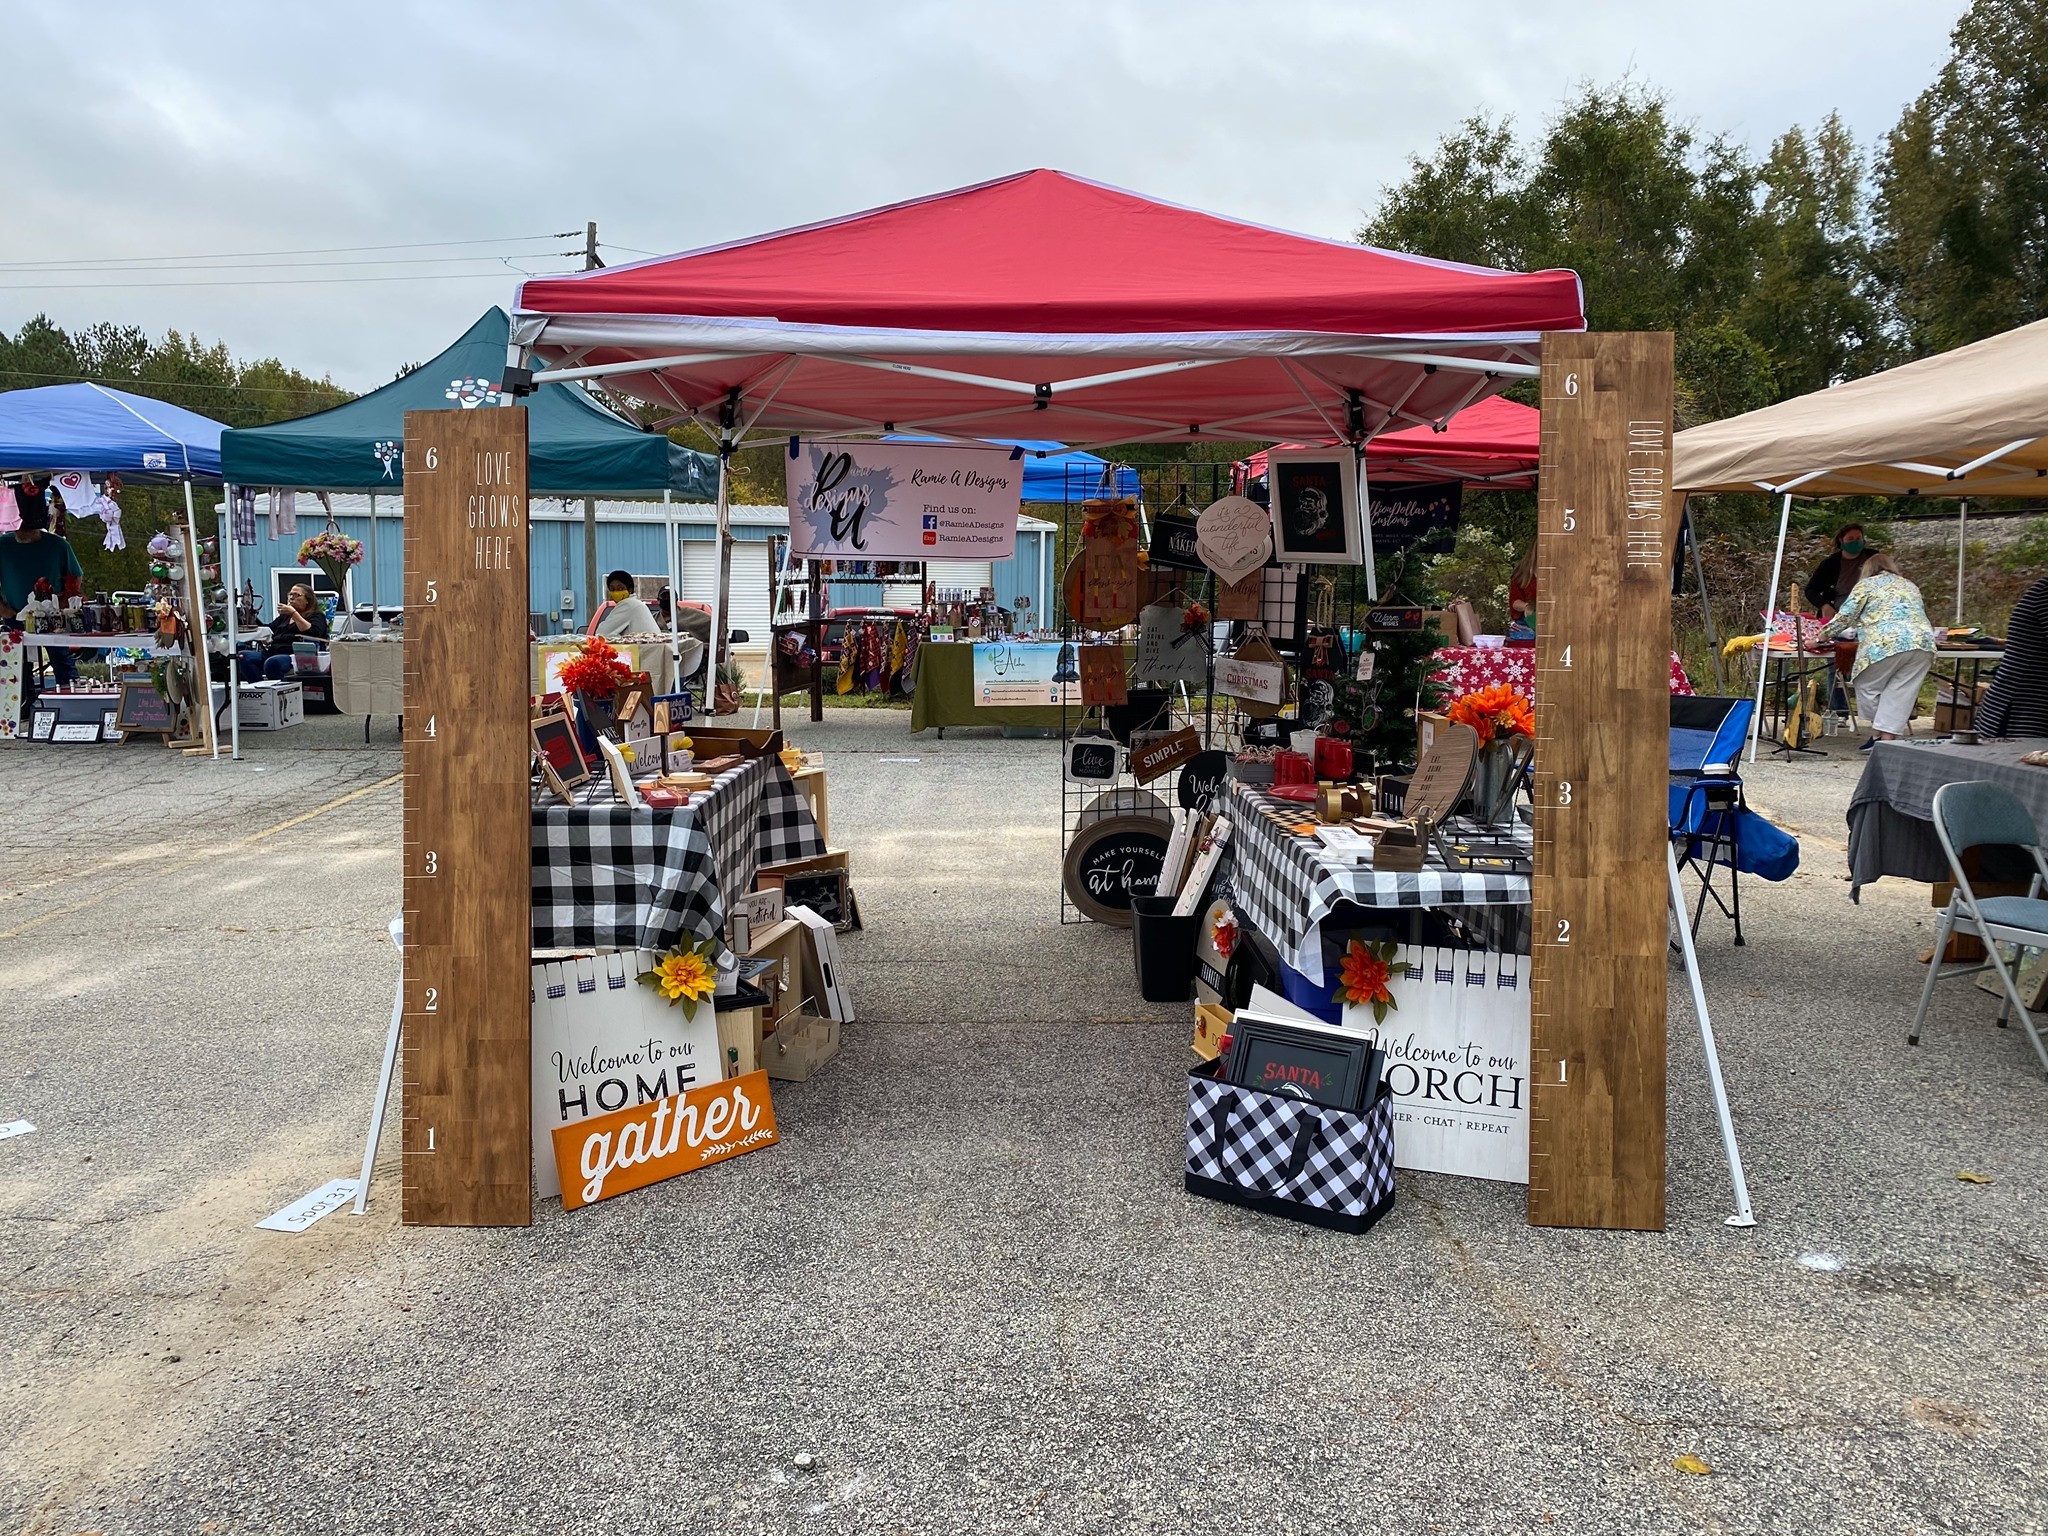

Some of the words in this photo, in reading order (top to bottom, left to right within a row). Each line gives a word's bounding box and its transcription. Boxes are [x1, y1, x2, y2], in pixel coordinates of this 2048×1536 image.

[1565, 373, 1578, 396] 6
[1628, 421, 1664, 456] LOVE
[426, 447, 437, 469] 6
[476, 452, 511, 486] LOVE
[911, 468, 947, 487] Ramie
[950, 470, 960, 486] A
[964, 470, 1009, 494] Designs
[803, 481, 874, 519] designs
[1628, 467, 1663, 521] GROWS
[468, 494, 519, 528] GROWS
[923, 504, 945, 514] Find
[948, 506, 960, 514] us
[962, 506, 976, 514] on:
[1562, 509, 1576, 531] 5
[939, 520, 1004, 530] @RamieADesigns
[1200, 512, 1264, 537] wonderful
[939, 534, 1004, 544] RamieADesigns
[1168, 536, 1196, 554] NAKED
[1211, 532, 1248, 555] life
[1627, 530, 1663, 569] HERE
[475, 536, 512, 570] HERE
[426, 580, 438, 603] 5
[1372, 612, 1400, 623] Warm
[1560, 645, 1573, 667] 4
[1226, 674, 1268, 690] CHRISTMAS
[671, 706, 692, 721] DAD
[424, 715, 436, 737] 4
[1074, 747, 1113, 766] live
[1143, 740, 1184, 768] SIMPLE
[1559, 782, 1572, 804] 3
[426, 851, 438, 874] 3
[1092, 848, 1116, 866] MAKE
[1120, 846, 1166, 862] YOURSELF
[1086, 864, 1120, 895] at
[1121, 858, 1159, 890] hom
[748, 899, 758, 908] YOU
[1558, 919, 1570, 942] 2
[426, 988, 438, 1010] 2
[1369, 1027, 1462, 1064] Welcome
[1458, 1042, 1483, 1068] to
[1488, 1056, 1518, 1070] our
[551, 1045, 644, 1084] Welcome
[640, 1038, 666, 1064] to
[669, 1042, 696, 1058] our
[1558, 1059, 1568, 1082] 1
[1264, 1062, 1320, 1090] SANTA
[1386, 1064, 1525, 1110] ORCH
[558, 1062, 698, 1121] HOME
[1424, 1116, 1456, 1128] CHAT
[1466, 1121, 1510, 1134] REPEAT
[427, 1126, 436, 1150] 1
[580, 1086, 760, 1204] gather
[288, 1200, 329, 1224] Spot
